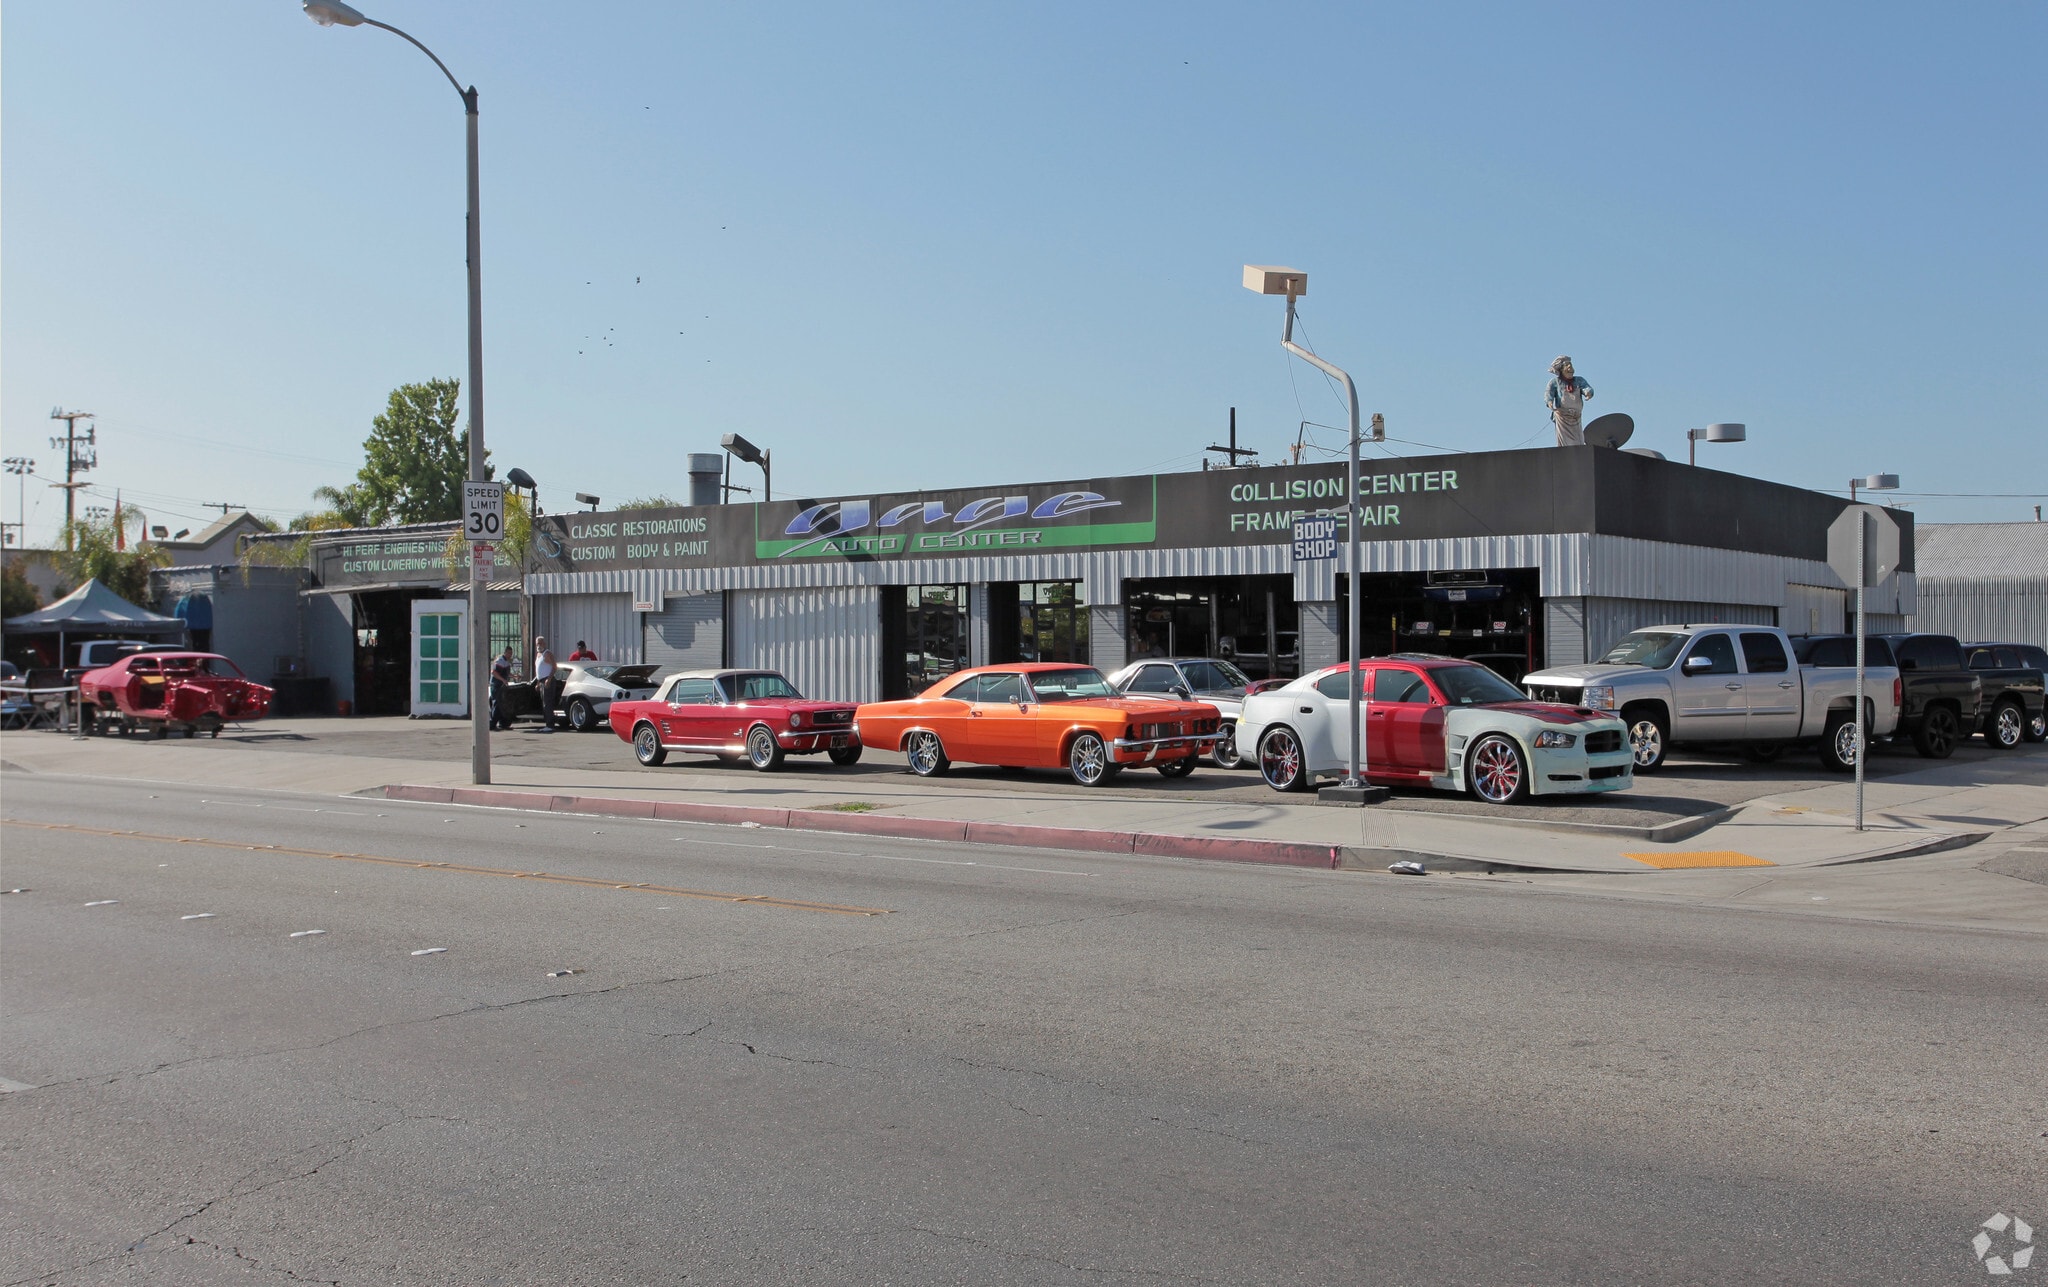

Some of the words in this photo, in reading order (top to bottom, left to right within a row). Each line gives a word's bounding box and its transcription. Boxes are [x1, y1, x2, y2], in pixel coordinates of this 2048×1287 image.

[467, 488, 500, 498] SPEED
[1230, 477, 1344, 502] COLLISION
[1358, 470, 1459, 495] CENTER
[471, 501, 497, 510] LIMIT
[468, 512, 500, 534] 30
[571, 522, 617, 539] CLASSIC
[623, 517, 707, 537] RESTORATIONS
[1294, 520, 1335, 540] BODY
[343, 546, 352, 557] HI
[355, 544, 380, 556] PERF
[384, 542, 425, 555] ENGINES
[571, 545, 616, 561] CUSTOM
[627, 543, 658, 559] BODY
[663, 543, 670, 557] &
[674, 540, 709, 556] PAINT
[820, 537, 897, 554] AUTO
[919, 530, 1042, 549] CENTER
[1294, 539, 1336, 559] SHOP
[343, 560, 380, 573] CUSTOM
[381, 557, 427, 571] LOWERING
